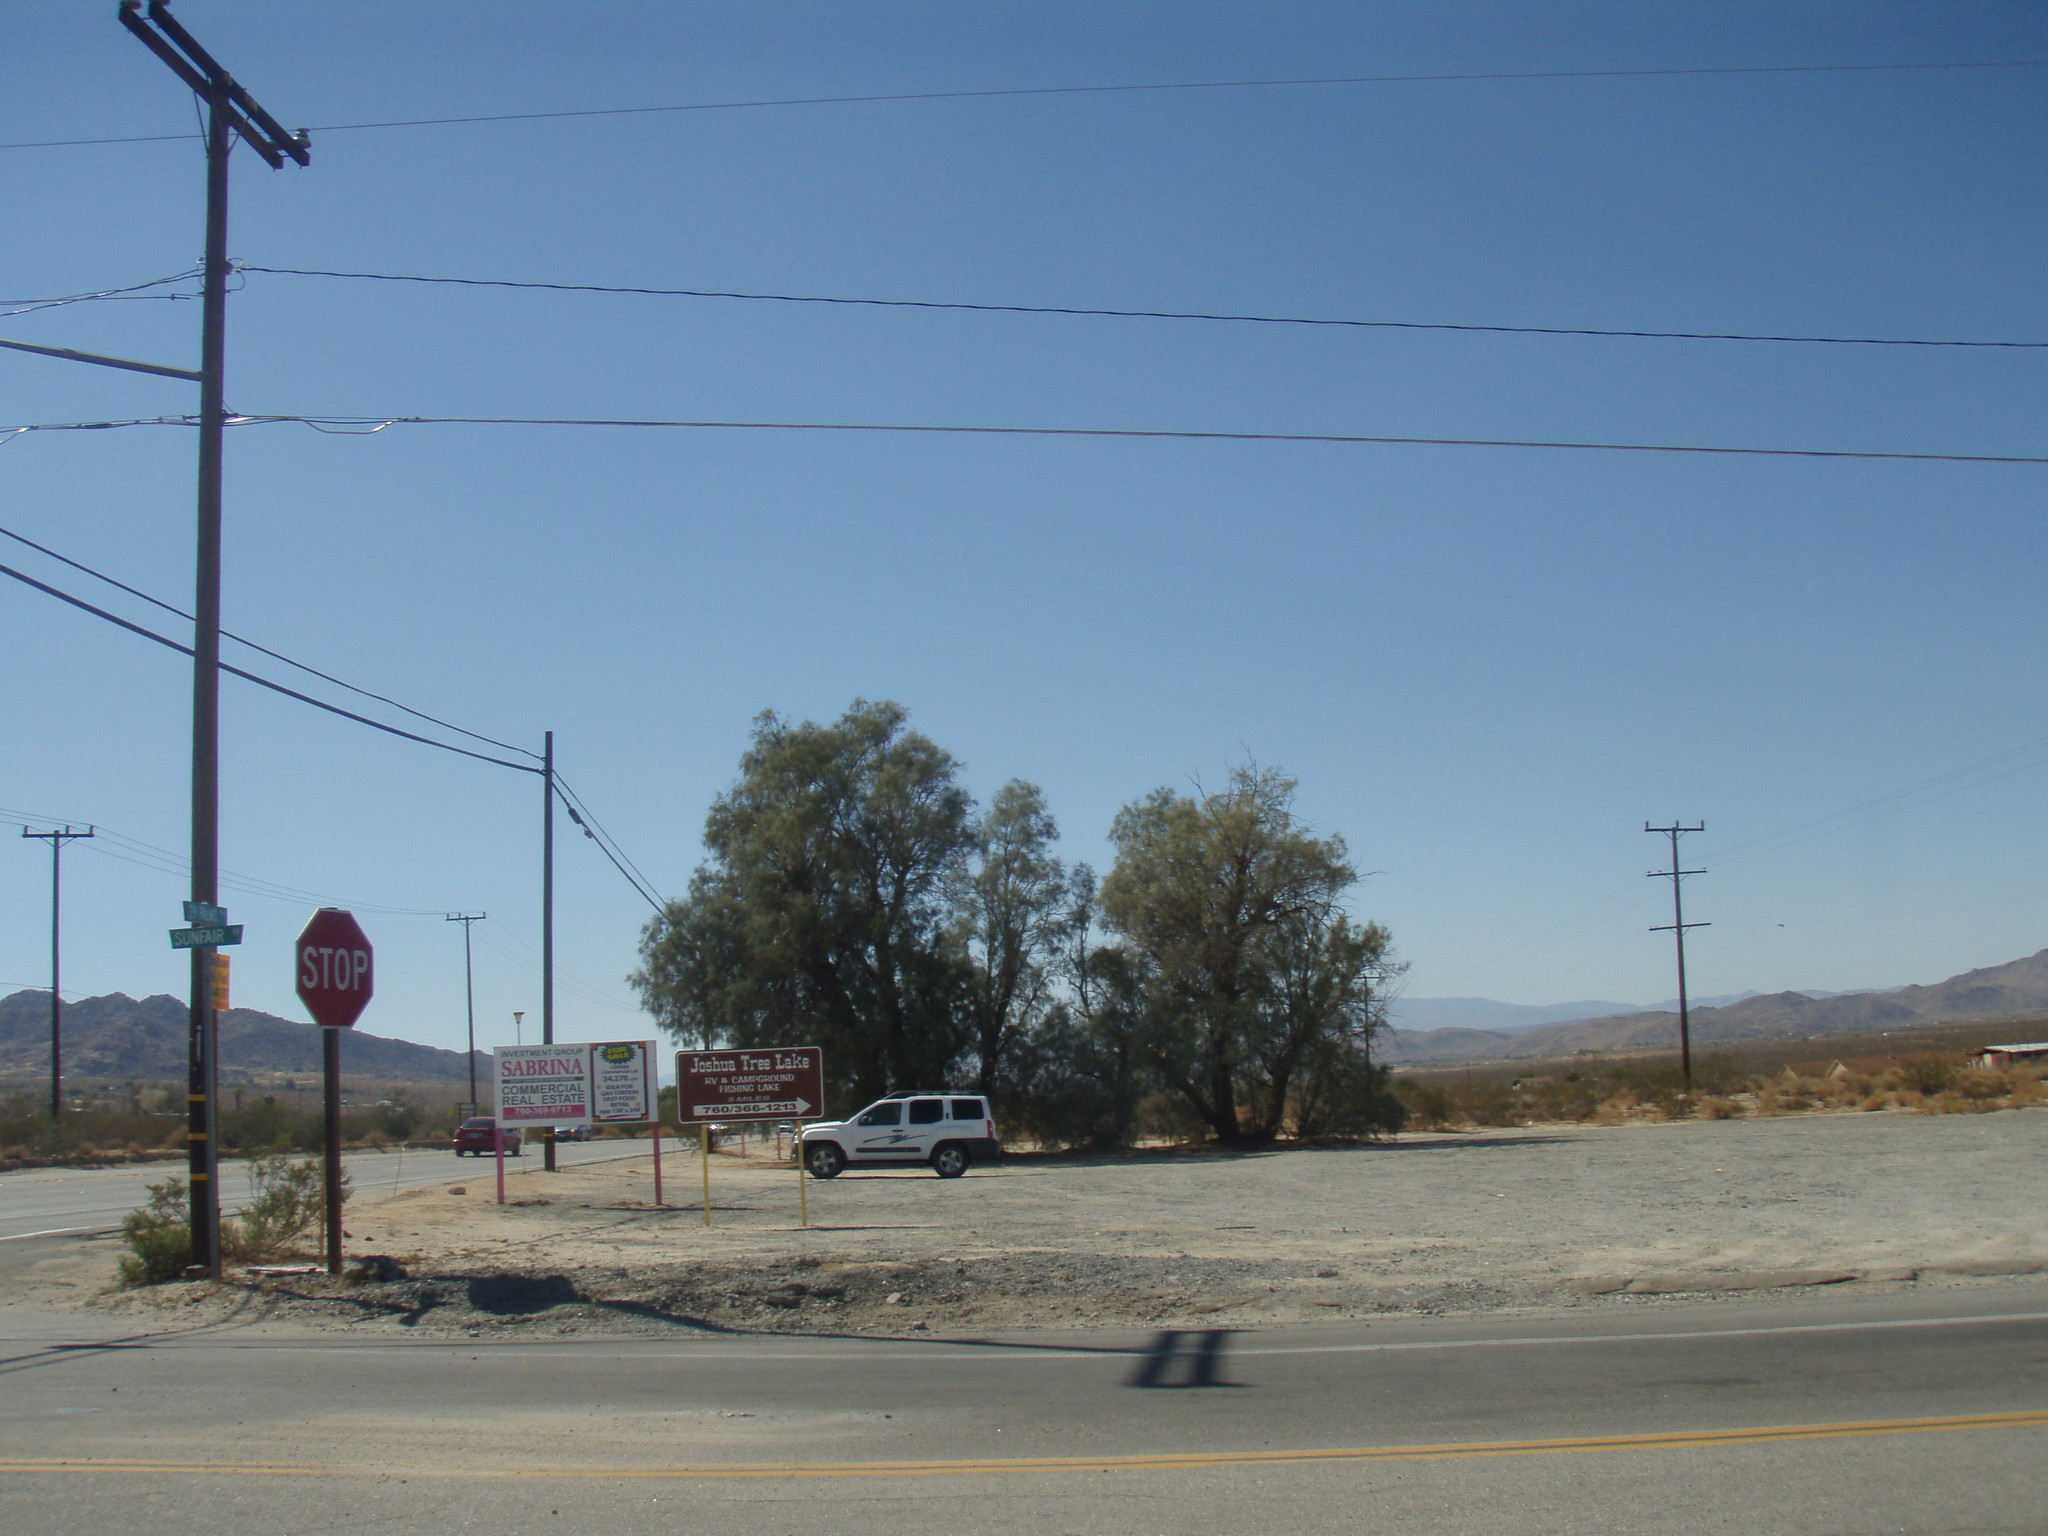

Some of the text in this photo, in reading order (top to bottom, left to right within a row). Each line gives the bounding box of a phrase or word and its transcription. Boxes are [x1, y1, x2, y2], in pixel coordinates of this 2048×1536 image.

[174, 929, 225, 946] SUNFAIR
[302, 946, 369, 990] STOP
[501, 1047, 584, 1058] INVESTMENT GROUP
[607, 1046, 628, 1054] FOR
[607, 1052, 630, 1060] SALE
[501, 1058, 584, 1077] SABRINA
[690, 1053, 810, 1073] Joshua Tree Lake
[705, 1073, 795, 1085] RV & CAMPGROUND
[502, 1083, 585, 1095] COMMERCIAL
[719, 1082, 781, 1093] FISHING LAKE
[502, 1093, 586, 1106] REAL ESTATE
[702, 1103, 797, 1114] 760/366-1213
